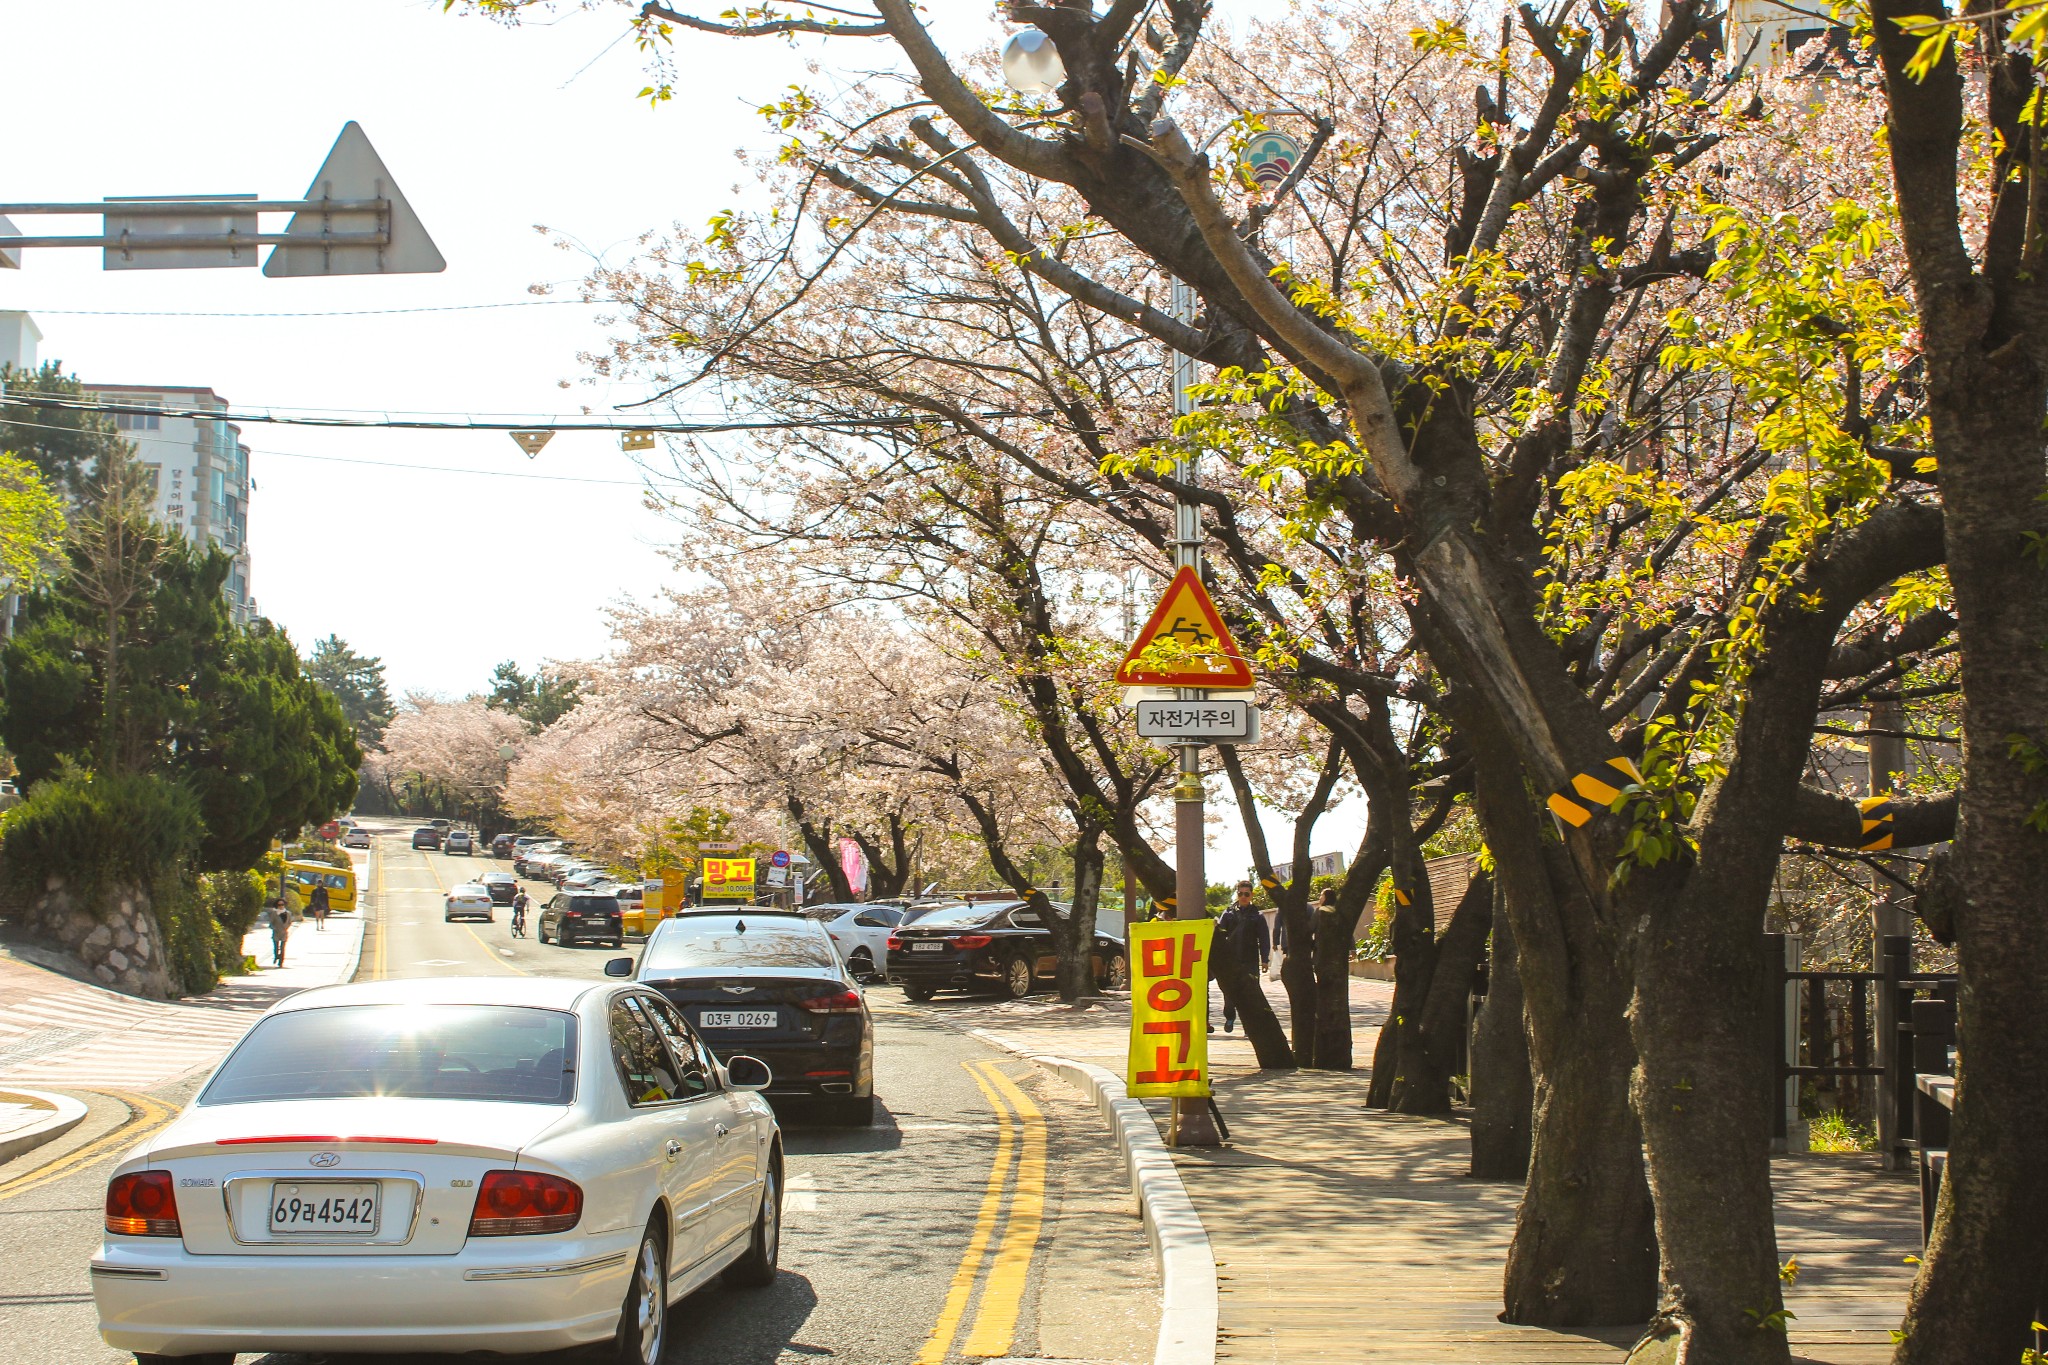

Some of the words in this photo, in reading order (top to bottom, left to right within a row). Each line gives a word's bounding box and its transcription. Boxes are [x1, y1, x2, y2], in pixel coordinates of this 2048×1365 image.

[1148, 709, 1236, 729] 자전거주의
[707, 860, 753, 885] 망고
[706, 1013, 732, 1026] 03무
[737, 1013, 771, 1026] 0269
[1136, 933, 1203, 1085] 망고
[450, 1179, 474, 1188] GOLD
[274, 1197, 374, 1224] 69라4542
